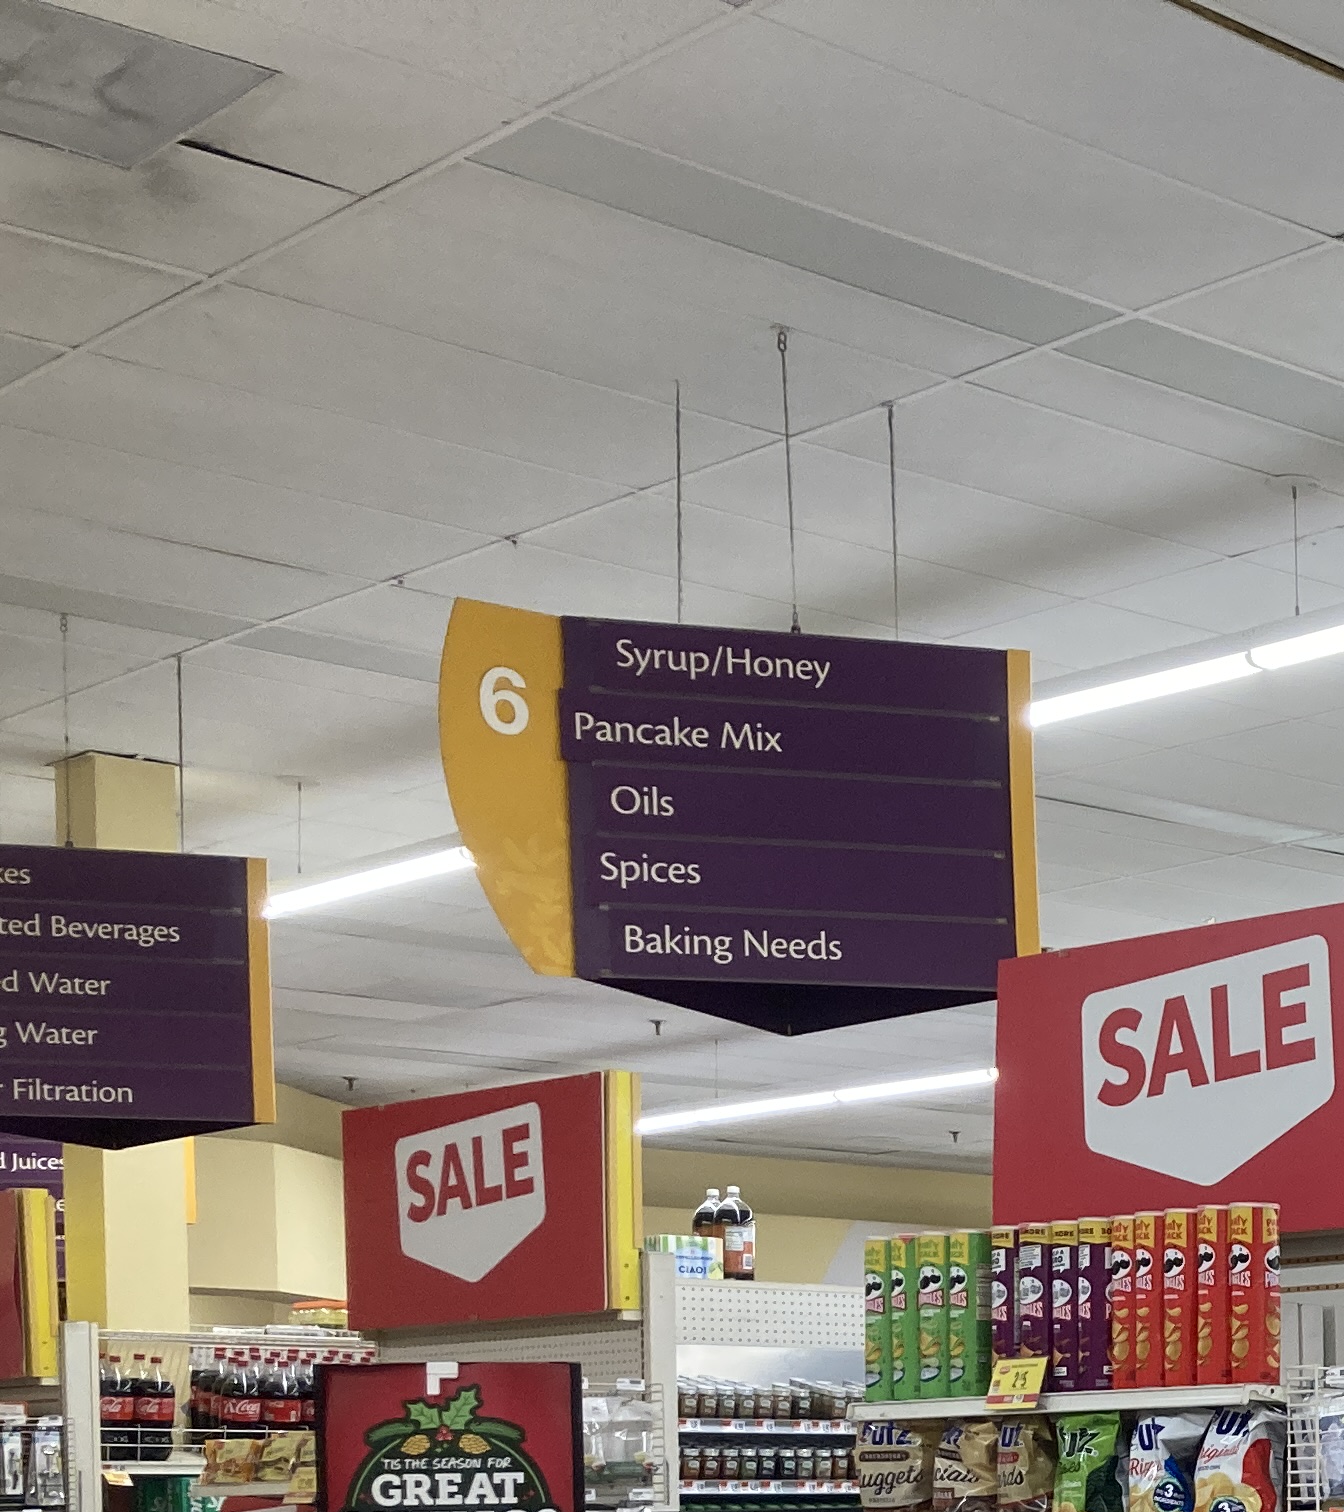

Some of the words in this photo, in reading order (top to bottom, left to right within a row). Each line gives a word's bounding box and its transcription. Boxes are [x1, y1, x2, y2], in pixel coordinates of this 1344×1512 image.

[616, 639, 830, 687] Syrup/Honey
[479, 667, 529, 735] 6
[575, 712, 709, 748] Pancake
[721, 722, 782, 753] Mix
[611, 786, 674, 817] Oils
[600, 853, 701, 888] Spices
[51, 916, 180, 948] Beverages
[625, 925, 732, 963] Baking
[744, 929, 842, 961] Needs
[29, 972, 110, 995] Water
[15, 1022, 98, 1045] Water
[1098, 963, 1316, 1107] SALE
[13, 1078, 133, 1103] Filtration
[406, 1123, 535, 1222] SALE
[405, 1459, 430, 1470] THE
[432, 1458, 481, 1469] SEASON
[487, 1457, 512, 1468] FOR
[371, 1472, 524, 1506] GREAT
